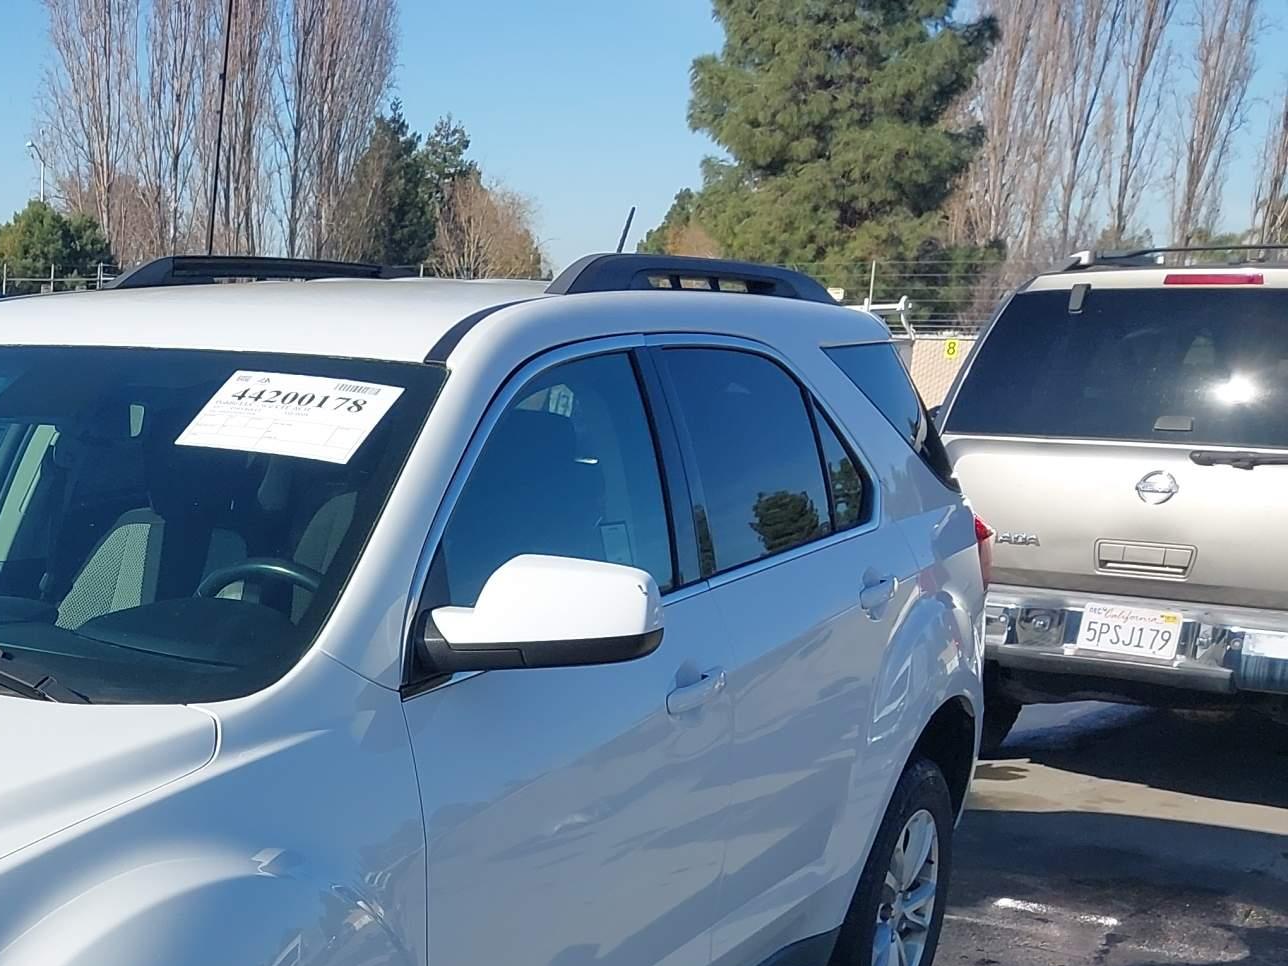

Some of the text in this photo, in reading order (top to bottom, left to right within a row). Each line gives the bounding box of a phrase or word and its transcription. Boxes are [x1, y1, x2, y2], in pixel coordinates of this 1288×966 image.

[947, 342, 955, 354] 8
[231, 387, 368, 413] 44200178
[1085, 620, 1172, 651] 5PSJ179
